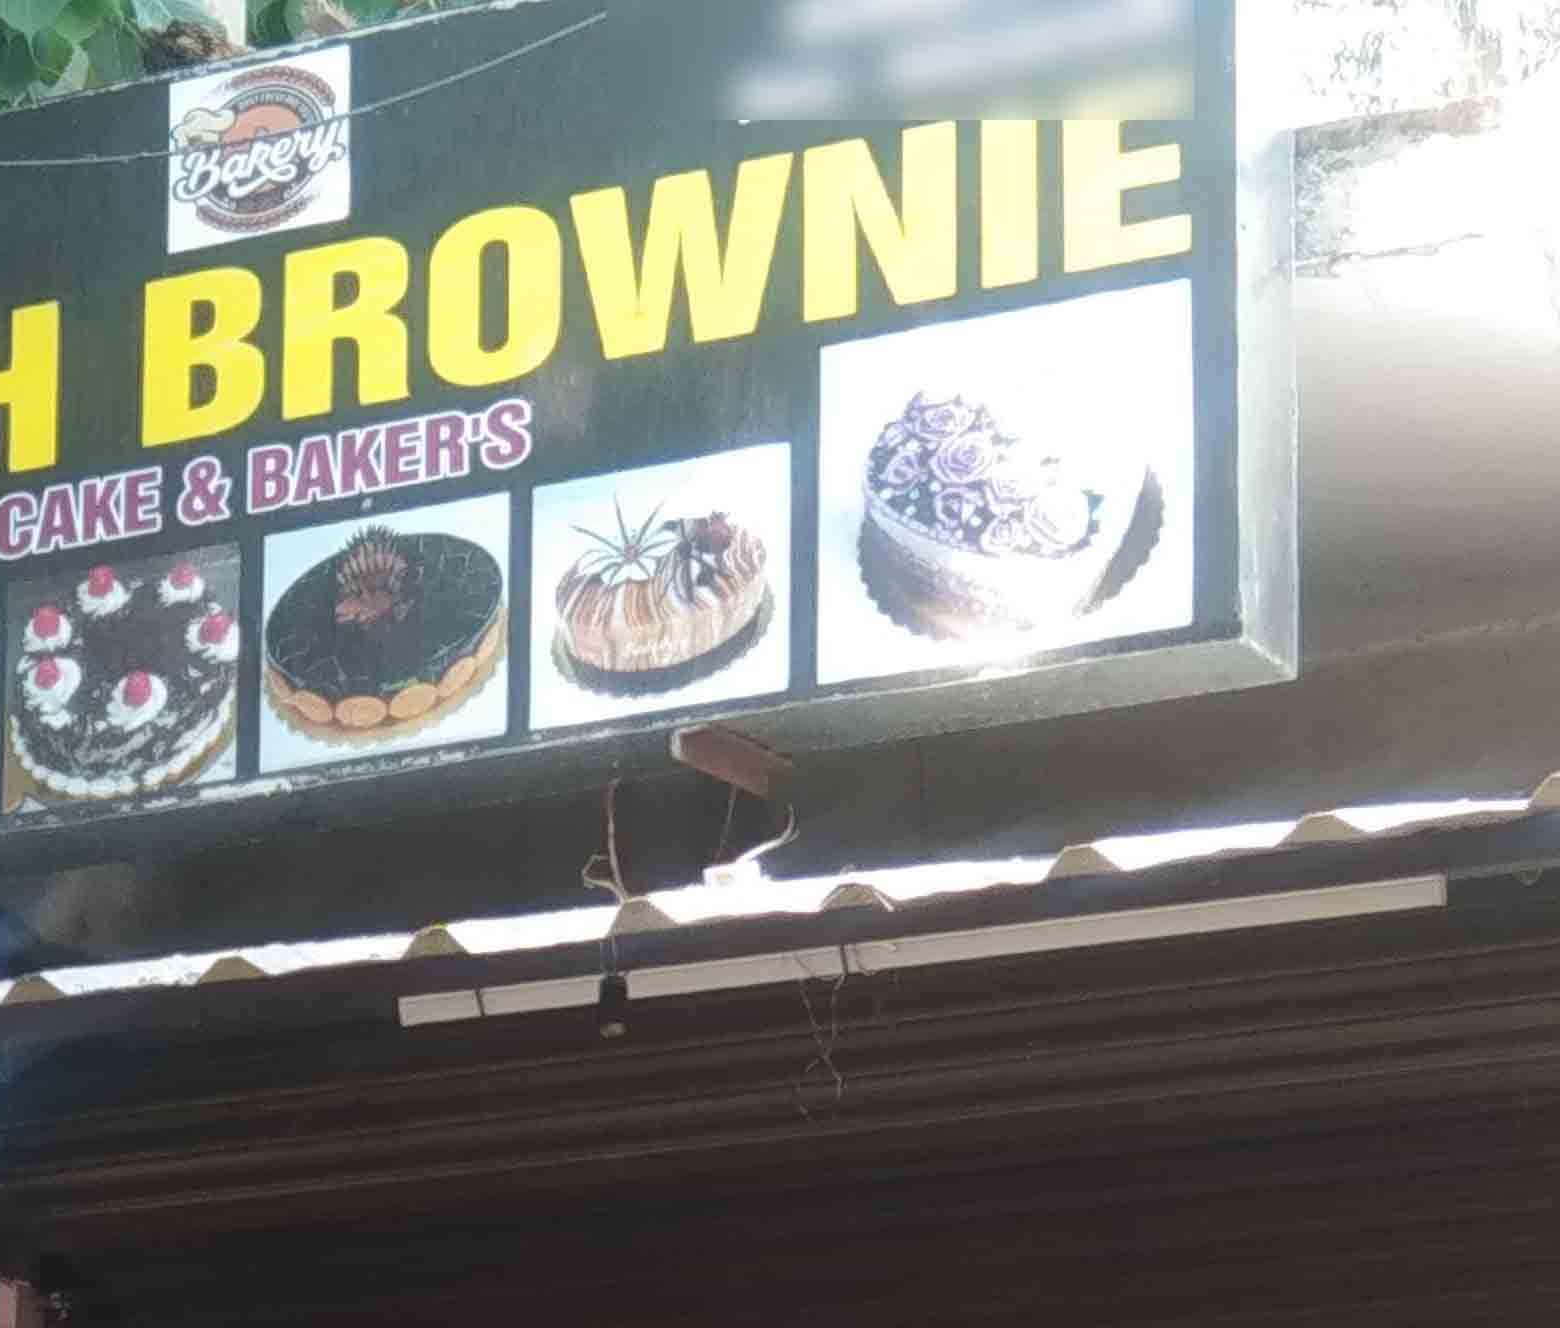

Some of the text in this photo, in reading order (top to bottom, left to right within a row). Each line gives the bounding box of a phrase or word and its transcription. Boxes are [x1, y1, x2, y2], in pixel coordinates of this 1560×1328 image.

[173, 115, 347, 202] Bakery
[141, 120, 1192, 449] BROWNIE
[178, 456, 232, 526] &
[247, 398, 533, 513] BAKER'S
